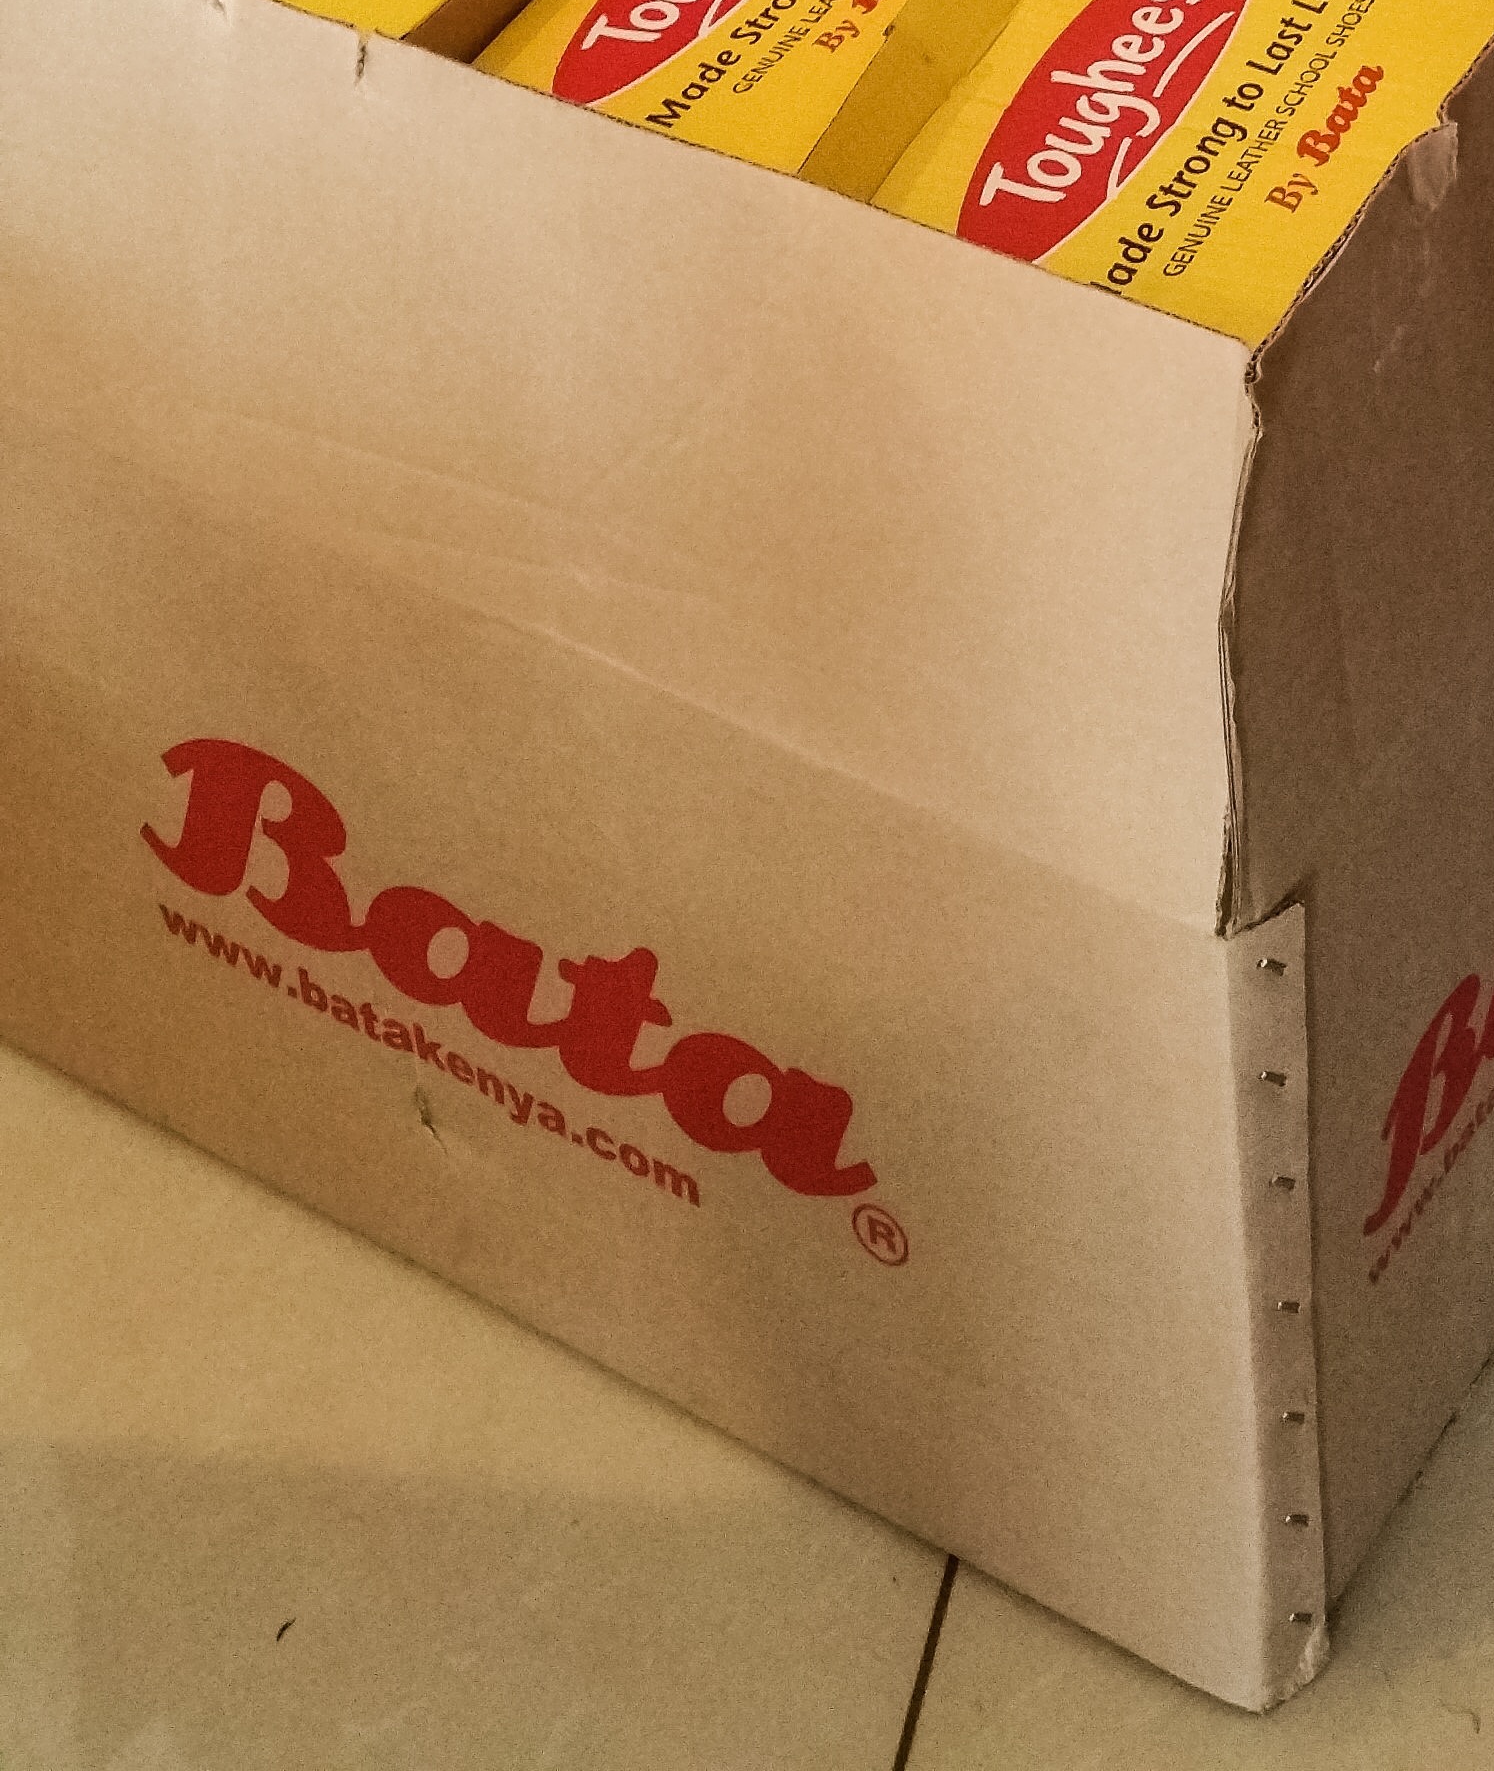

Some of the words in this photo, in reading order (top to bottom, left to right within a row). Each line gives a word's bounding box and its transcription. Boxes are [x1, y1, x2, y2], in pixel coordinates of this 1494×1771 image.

[645, 49, 741, 129] Made
[733, 17, 811, 94] GENUINE
[813, 19, 861, 53] By
[1149, 113, 1249, 217] Strong
[1223, 83, 1264, 112] to
[1246, 14, 1313, 76] Last
[1163, 195, 1233, 277] GENUINE
[1228, 115, 1291, 195] LEATHER
[1280, 48, 1339, 119] SCHOOL
[1265, 174, 1320, 213] By
[1297, 64, 1385, 167] Bata
[139, 737, 879, 1197] Bata
[158, 902, 702, 1209] www.batakenya.com
